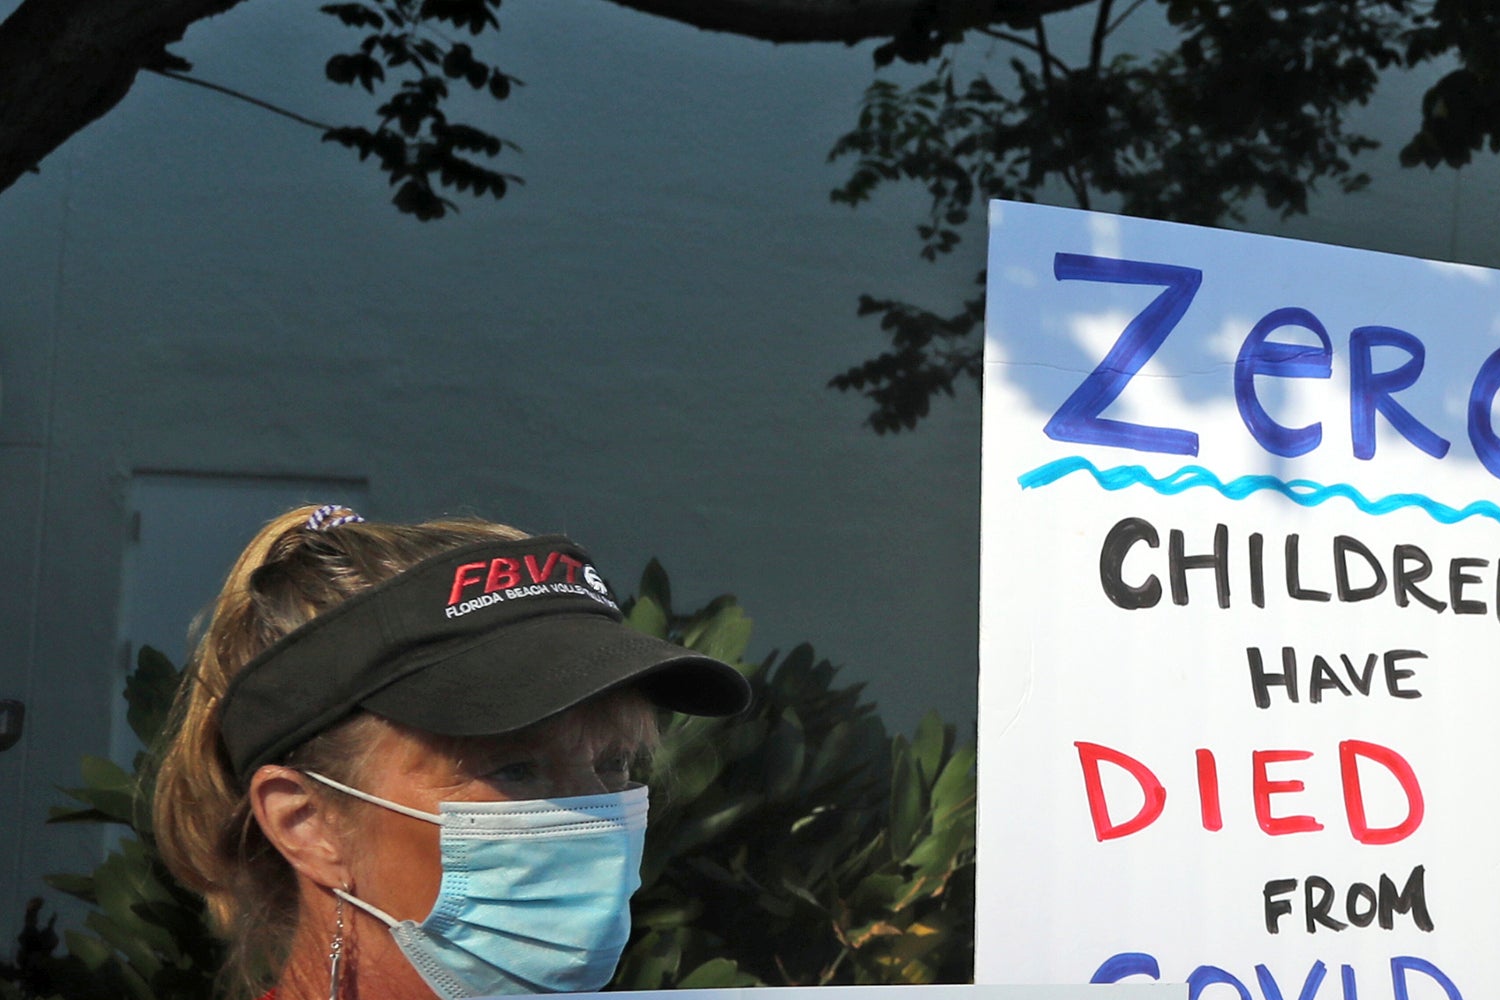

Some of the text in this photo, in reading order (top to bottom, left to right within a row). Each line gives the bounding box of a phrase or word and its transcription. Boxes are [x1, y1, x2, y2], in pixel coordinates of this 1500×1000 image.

[445, 592, 504, 618] FLORIDA
[505, 583, 550, 601] BEACH
[447, 551, 583, 606] FBVT
[1246, 646, 1429, 710] HAVE
[1074, 738, 1425, 845] DIED
[1262, 864, 1436, 934] FROM
